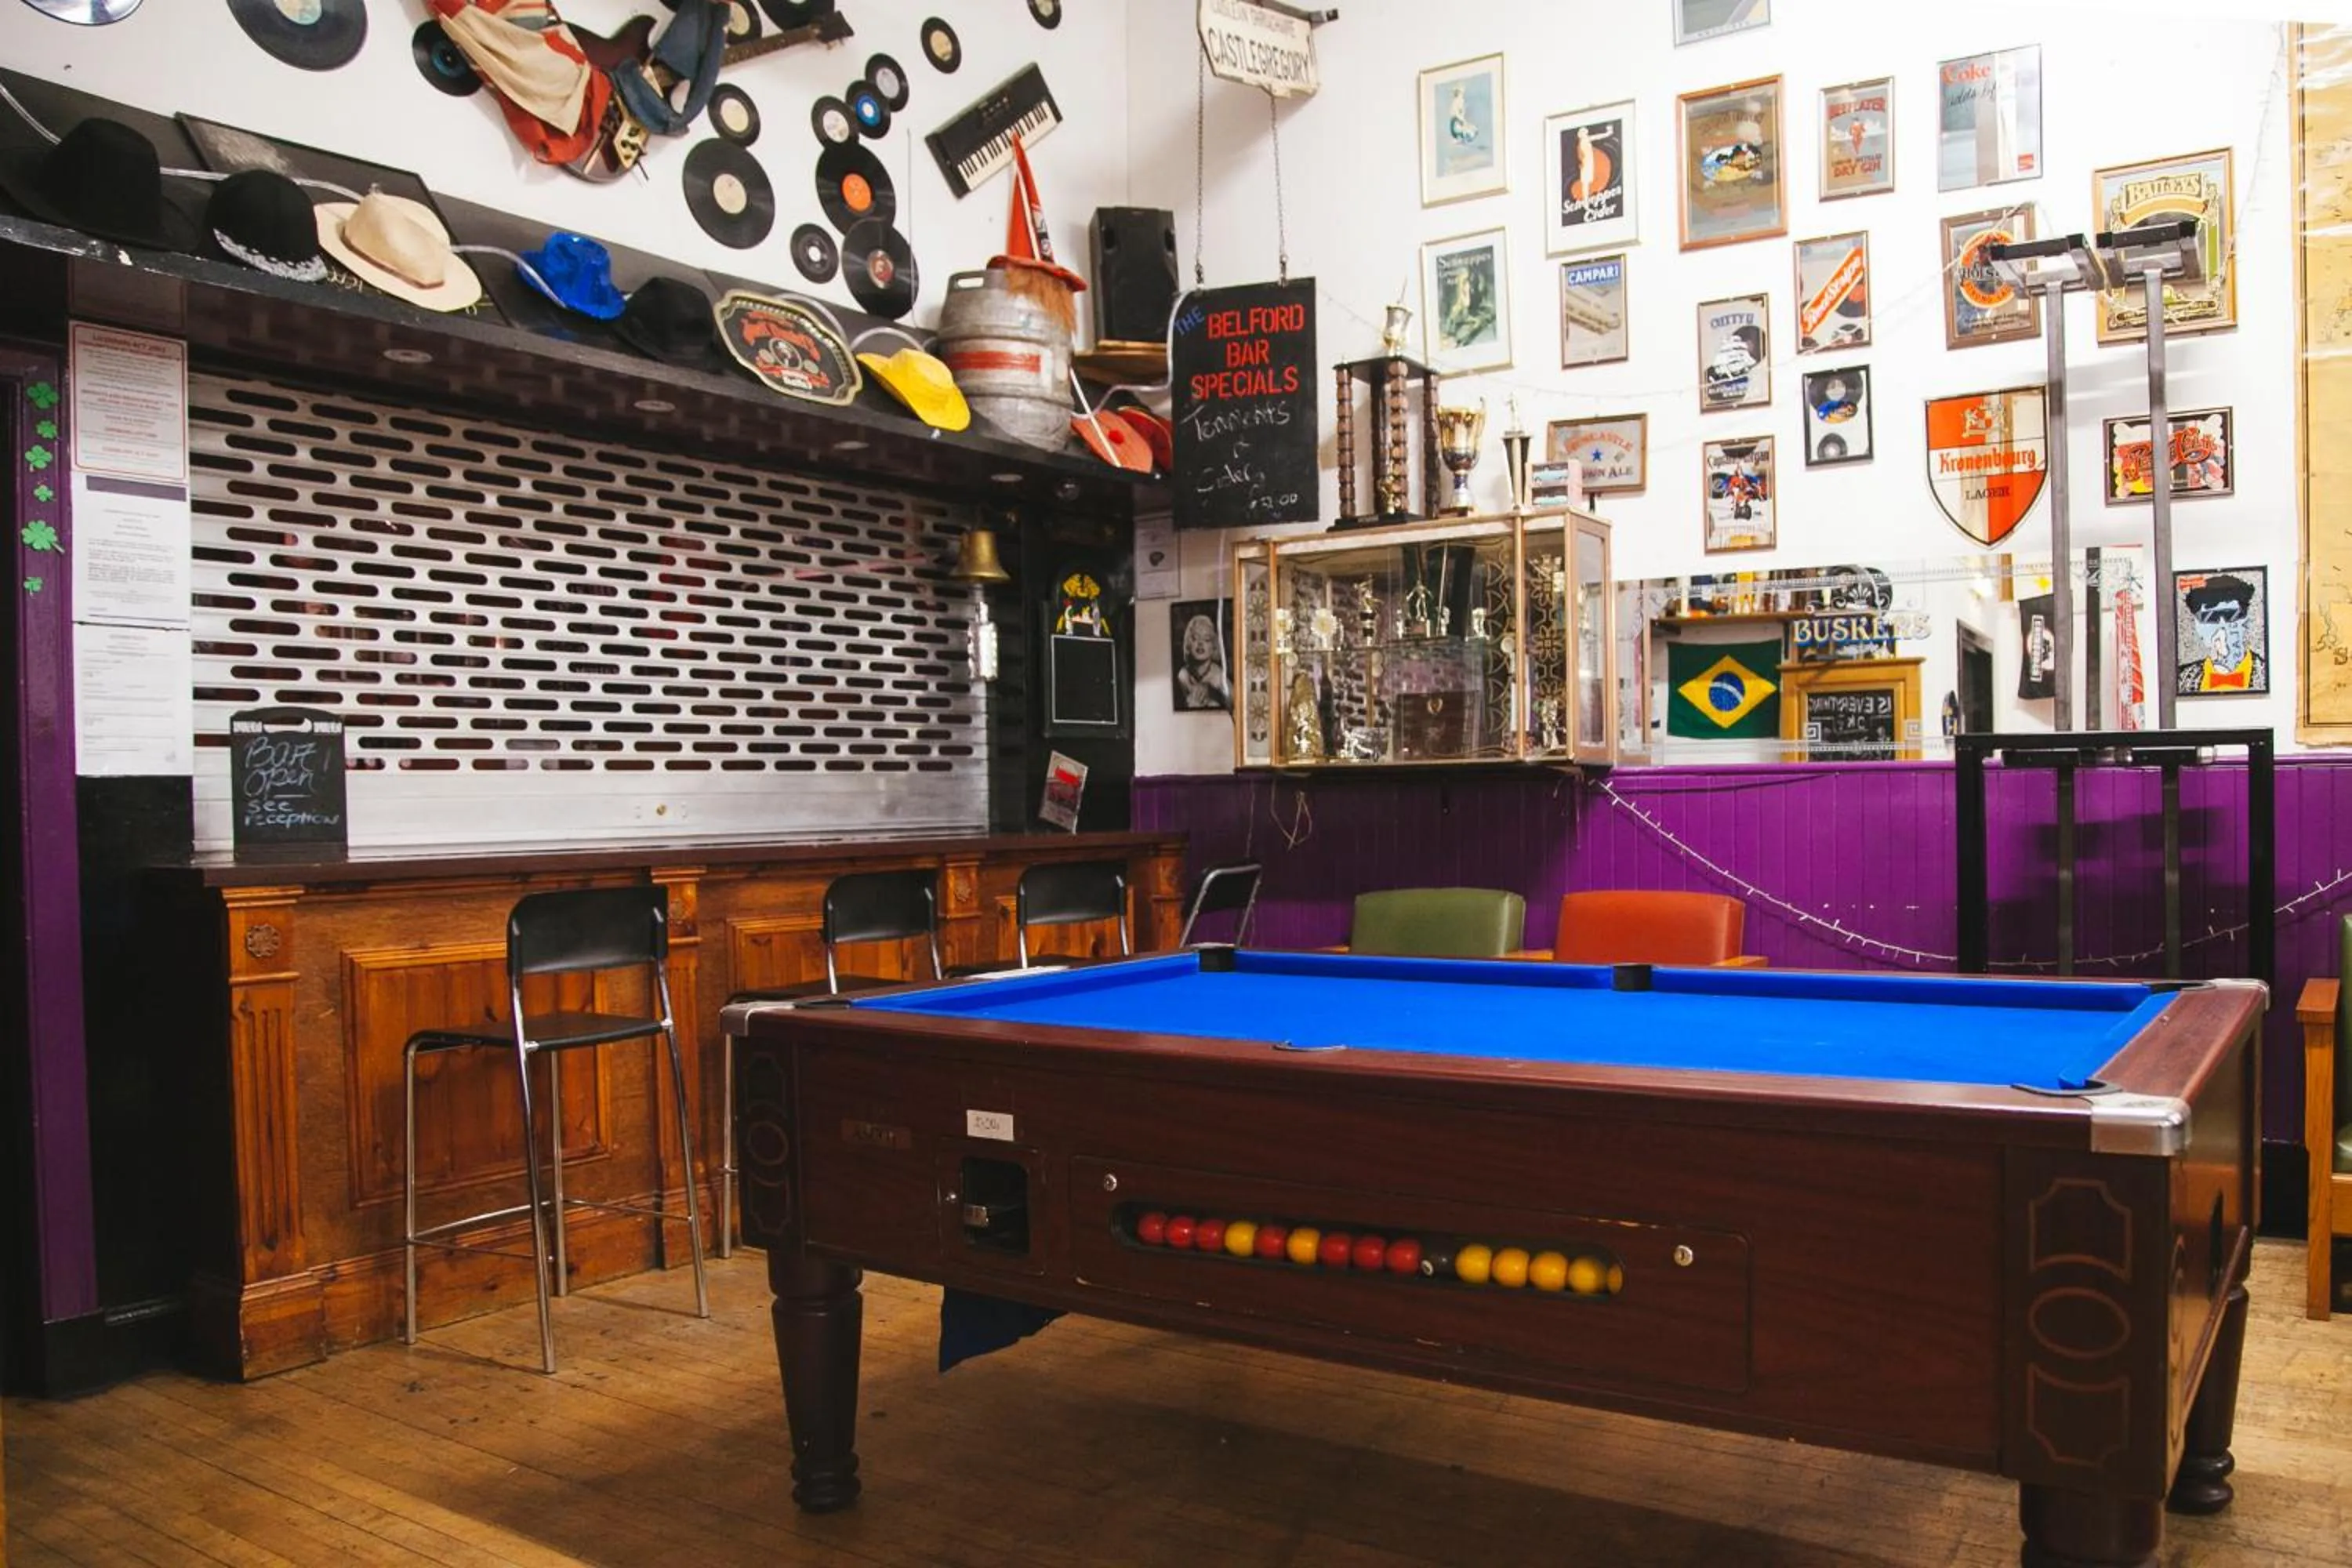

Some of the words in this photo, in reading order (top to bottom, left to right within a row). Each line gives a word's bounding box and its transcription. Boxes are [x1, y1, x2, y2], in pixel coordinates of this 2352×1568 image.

[1208, 27, 1310, 83] CASTLEGREGORY
[1942, 63, 1991, 86] Coke
[1833, 164, 1857, 177] DRY
[1568, 265, 1620, 285] CAMPARI
[1175, 305, 1205, 336] THE
[1207, 303, 1305, 339] BELFORD
[1226, 339, 1270, 368] BAR
[1189, 366, 1300, 401] SPECIALS
[1940, 448, 2036, 474] Kronenbourg
[1965, 485, 2010, 500] LAGER
[1793, 611, 1933, 645] BUSKERS
